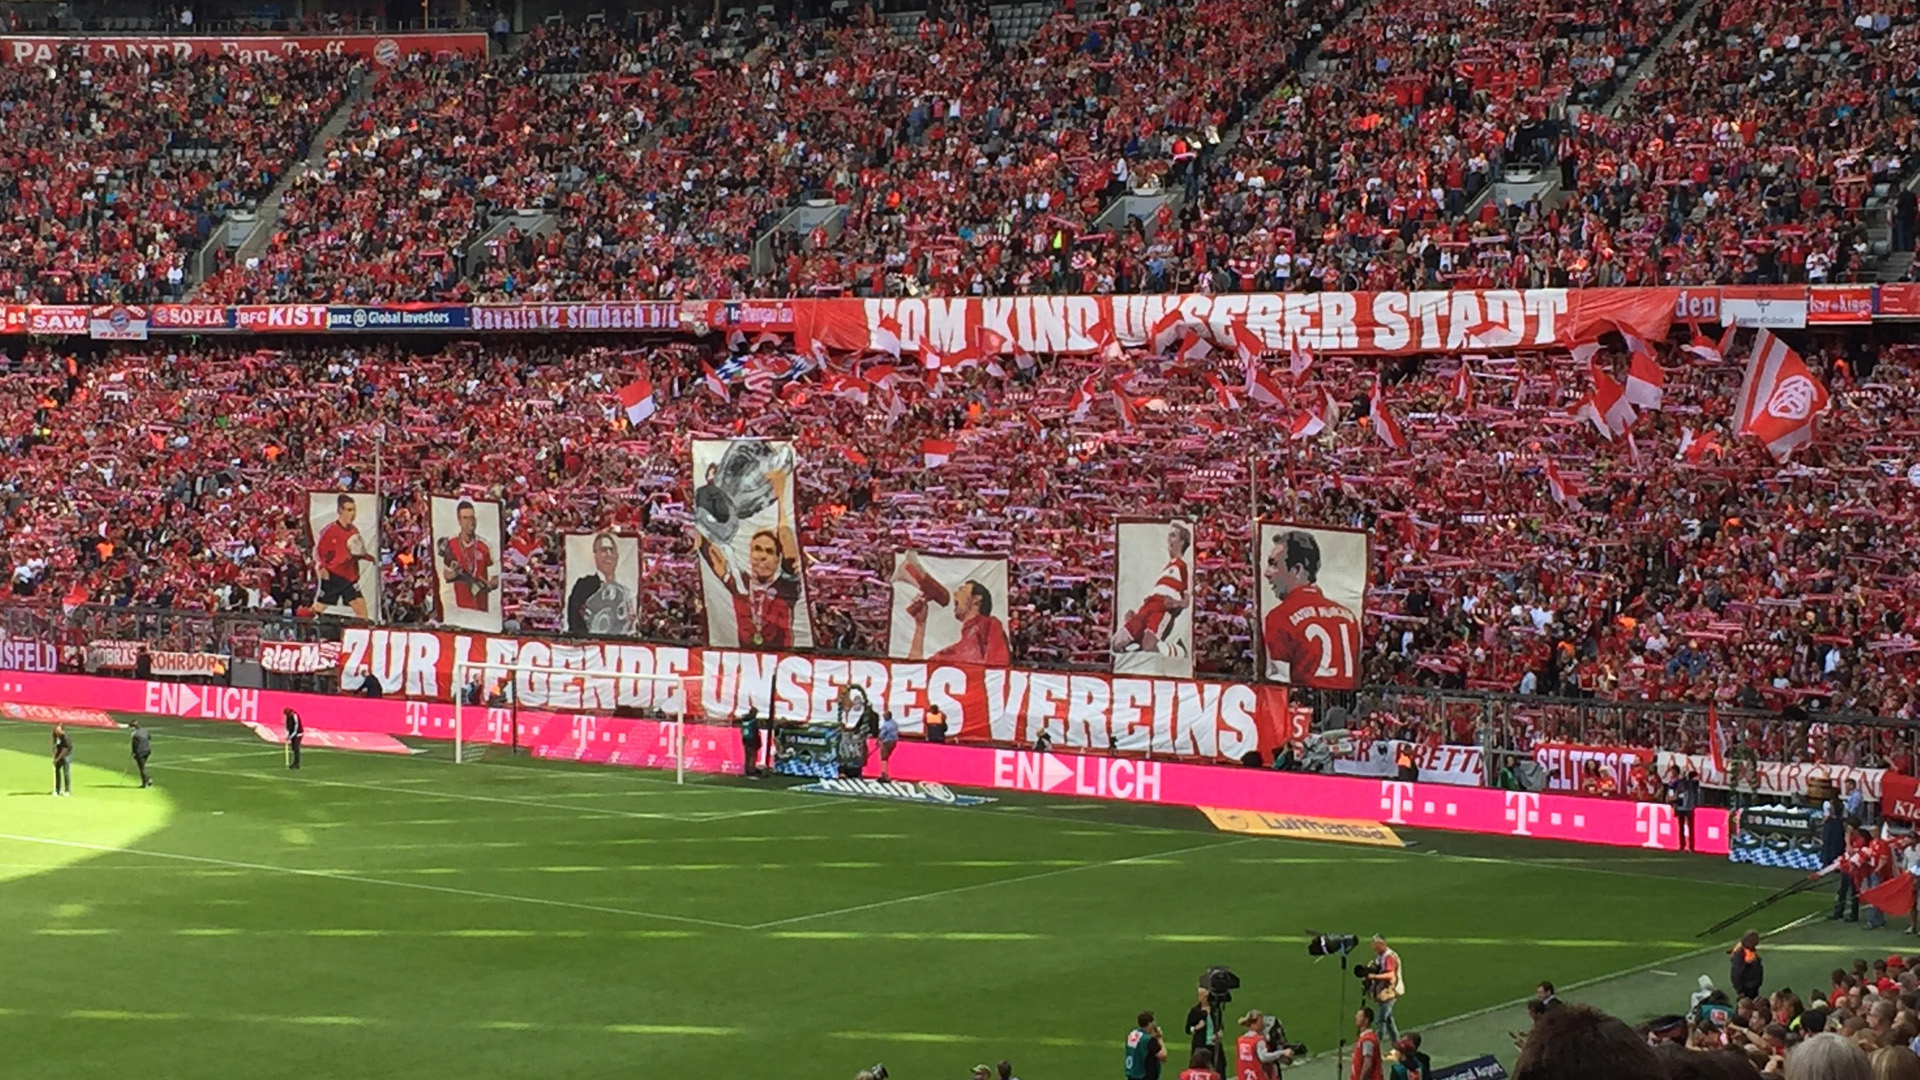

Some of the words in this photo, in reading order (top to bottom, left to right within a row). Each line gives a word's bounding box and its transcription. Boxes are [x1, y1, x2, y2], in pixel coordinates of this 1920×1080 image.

[13, 42, 193, 64] PALANER
[32, 315, 86, 329] SAW
[169, 309, 226, 324] SOFIA
[241, 312, 267, 324] BFC
[267, 307, 326, 326] KIST
[368, 311, 402, 324] Global
[403, 310, 450, 324] Investors
[568, 304, 644, 329] Simbach
[864, 298, 966, 354] VOM
[981, 297, 1101, 355] KIND
[1373, 288, 1568, 351] STADT
[1305, 623, 1353, 678] 21
[342, 628, 440, 697] ZUR
[453, 638, 687, 716] LEGENDE
[701, 650, 967, 738] UNSERES
[984, 669, 1258, 762] VEREINS
[1257, 814, 1387, 841] Lufthansa
